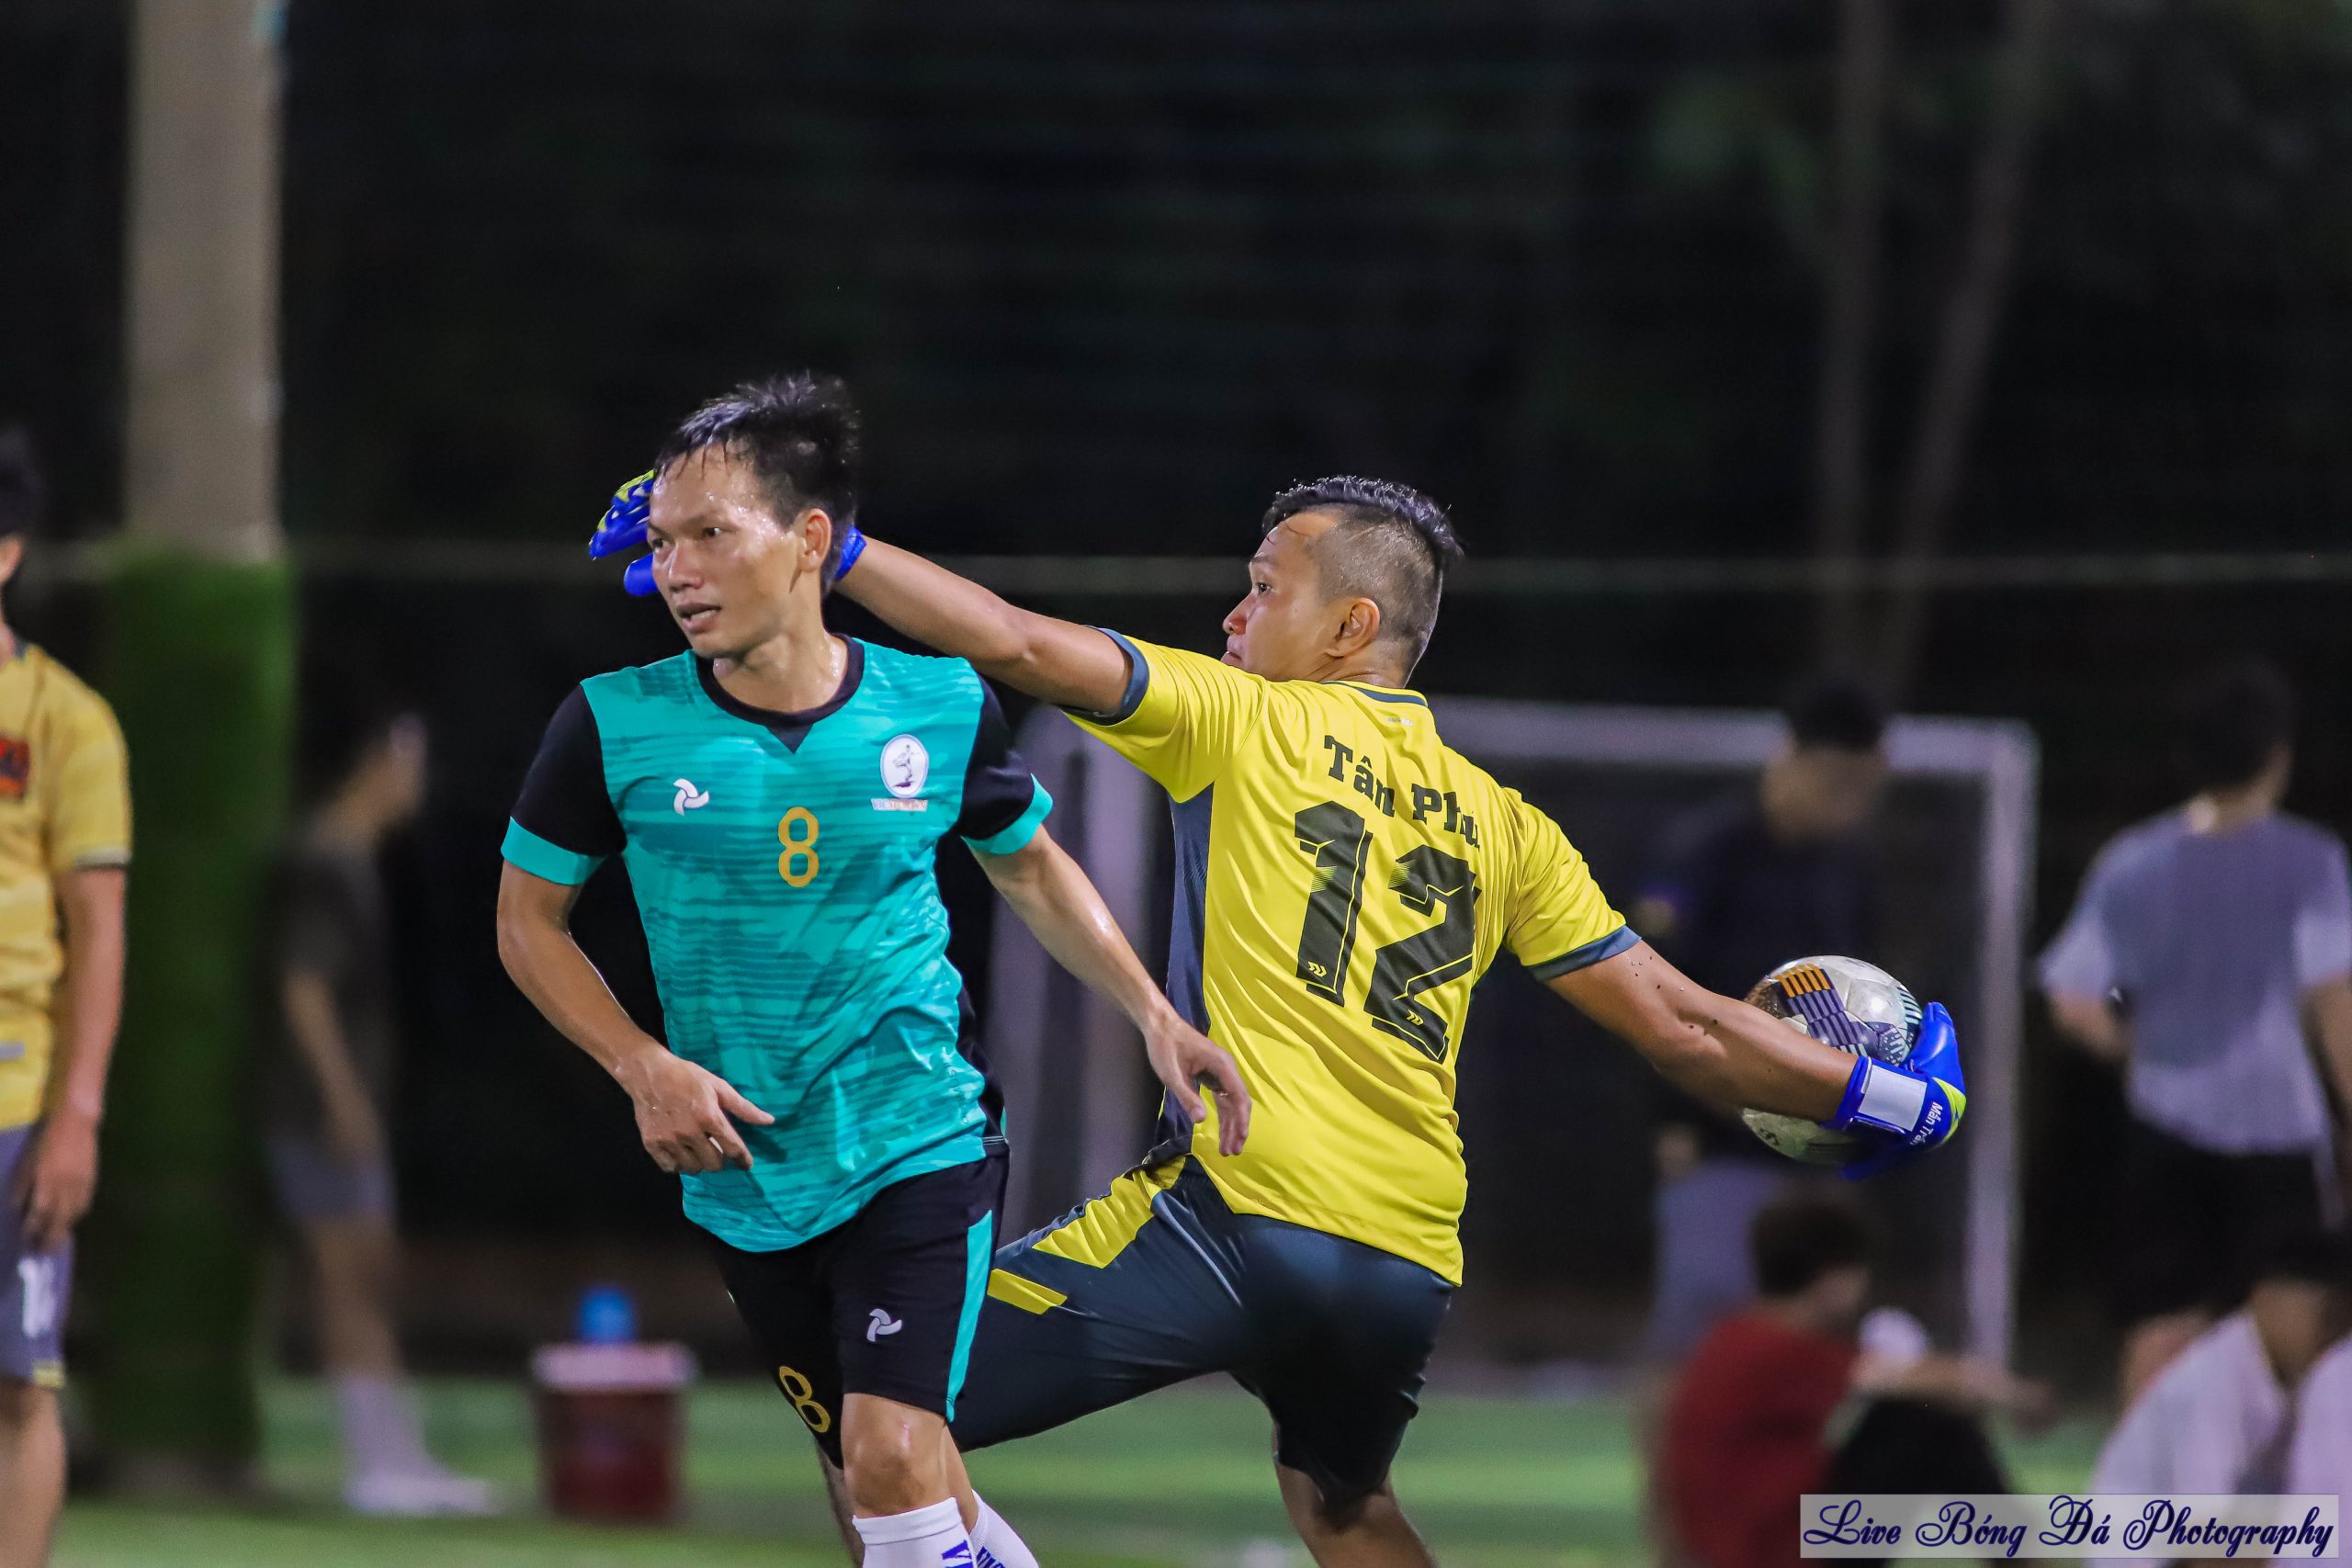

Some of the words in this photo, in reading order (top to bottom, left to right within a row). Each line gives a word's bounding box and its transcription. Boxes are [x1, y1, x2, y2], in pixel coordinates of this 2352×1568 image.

[1324, 735, 1396, 818] Tân
[777, 807, 820, 888] 8
[1295, 800, 1482, 1065] 12
[778, 1366, 831, 1433] 8
